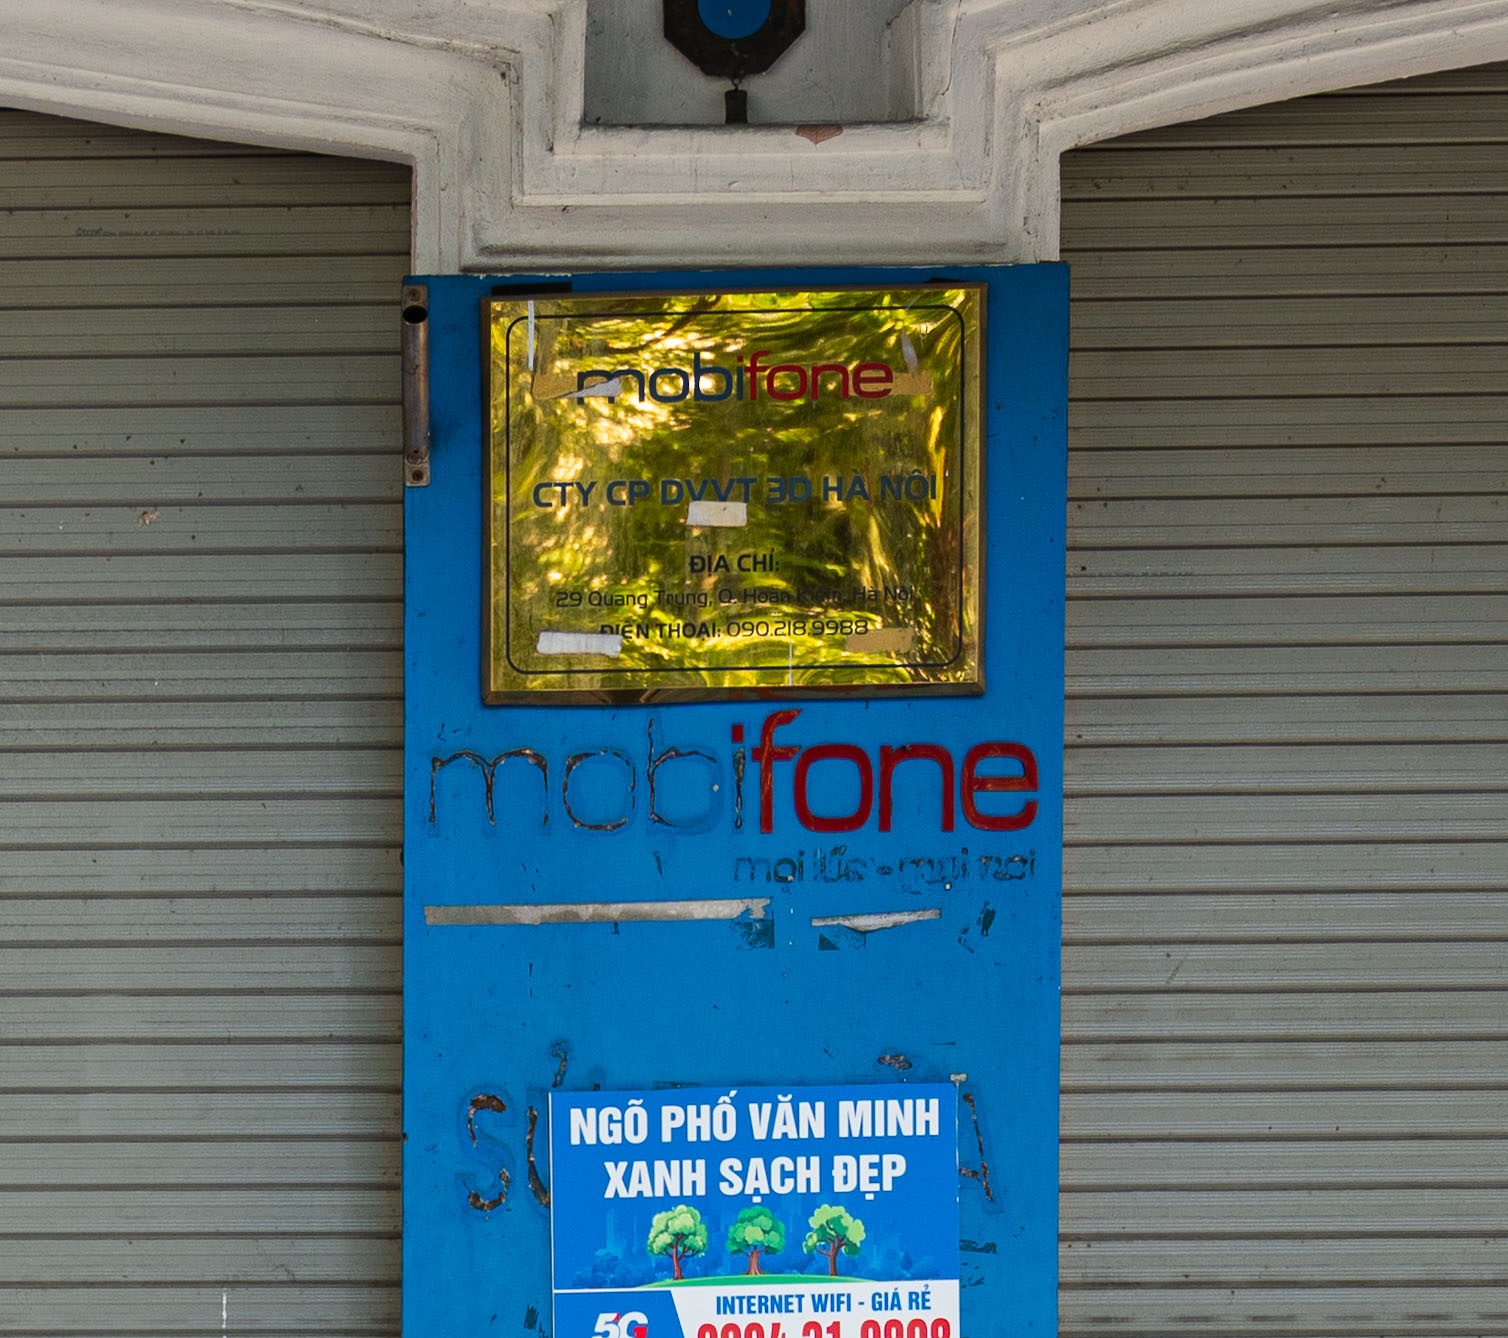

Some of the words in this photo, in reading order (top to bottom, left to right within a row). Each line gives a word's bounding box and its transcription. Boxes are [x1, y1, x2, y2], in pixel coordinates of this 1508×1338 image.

[577, 350, 894, 404] mobifone
[533, 481, 593, 508] CTY
[607, 480, 650, 506] CP
[662, 476, 758, 506] DVVT
[768, 476, 812, 502] 3D
[823, 468, 870, 501] HÀ
[688, 554, 730, 580] ĐỊA
[737, 549, 780, 573] CHỈ:
[556, 591, 583, 607] 29
[588, 590, 648, 609] Quang
[654, 589, 713, 607] Trung,
[655, 622, 721, 641] THOẠI:
[727, 619, 868, 637] 090.218.9988
[569, 1098, 649, 1146] NGÕ
[660, 1089, 739, 1144] PHỐ
[748, 1093, 826, 1140] VĂN
[838, 1098, 940, 1139] MINH
[603, 1158, 706, 1199] XANH
[718, 1155, 822, 1203] SẠCH
[831, 1153, 907, 1201] ĐẸP
[715, 1294, 805, 1316] INTERNET
[806, 1292, 852, 1315] WIFI
[871, 1287, 901, 1312] GIÁ
[908, 1283, 932, 1311] RẺ
